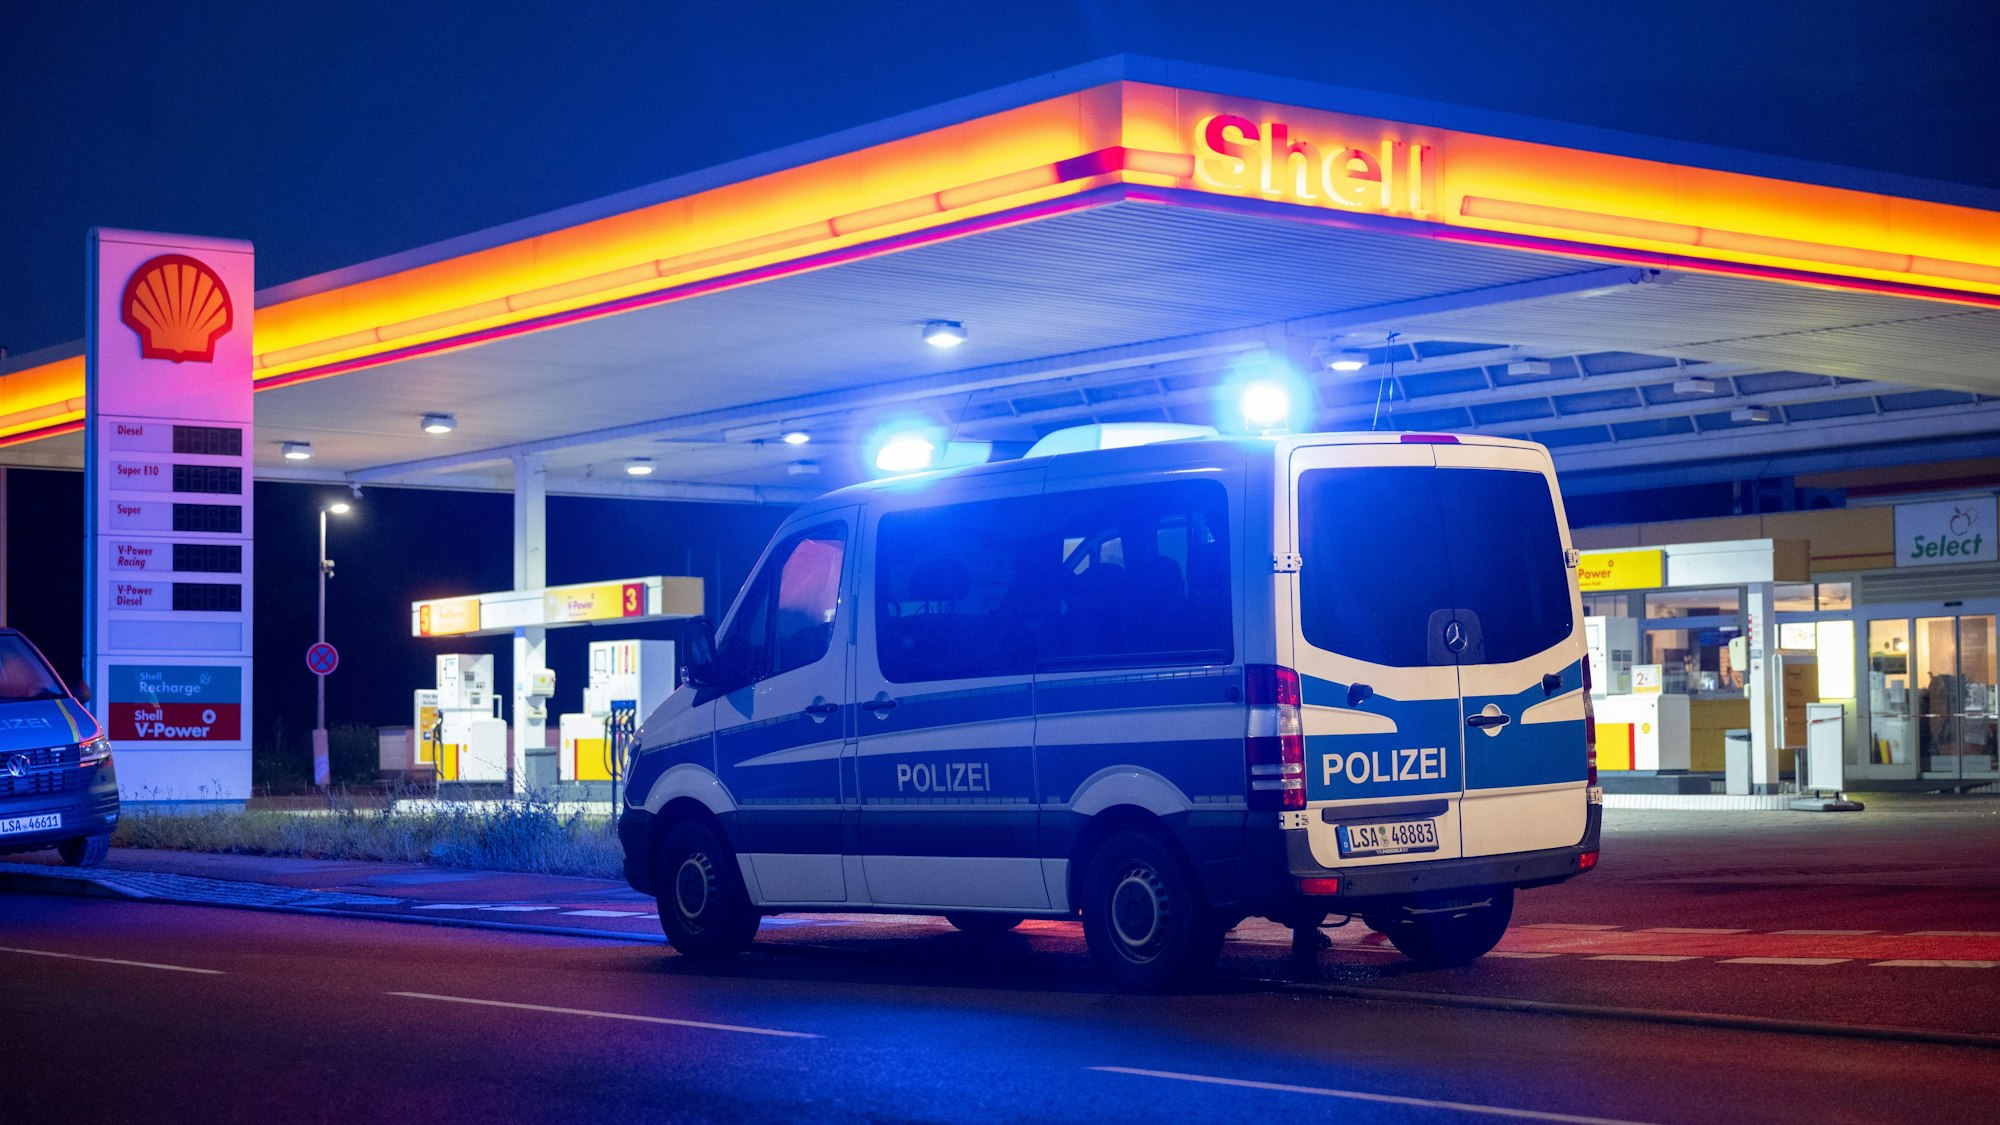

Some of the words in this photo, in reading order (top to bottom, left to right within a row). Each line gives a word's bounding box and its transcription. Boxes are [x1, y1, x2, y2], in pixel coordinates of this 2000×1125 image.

[1195, 114, 1437, 214] Shell
[117, 425, 143, 436] Diesel
[117, 465, 141, 478] Super
[144, 466, 159, 476] E10
[117, 504, 142, 517] Super
[118, 545, 153, 556] V-Power
[1911, 533, 1983, 558] Select
[117, 556, 146, 569] Racing
[1578, 568, 1612, 579] Power
[117, 585, 152, 595] V-Power
[117, 596, 142, 606] Diesel
[626, 588, 637, 612] 3
[140, 672, 162, 681] Shell
[140, 681, 201, 696] Recharge
[135, 709, 163, 721] Shell
[135, 722, 210, 738] V-Power
[1322, 747, 1446, 786] POLIZEI
[897, 763, 991, 792] POLIZEI
[2, 819, 22, 832] LSA
[28, 815, 59, 829] 46611
[1350, 827, 1379, 848] LSA
[1391, 823, 1434, 845] 48883
